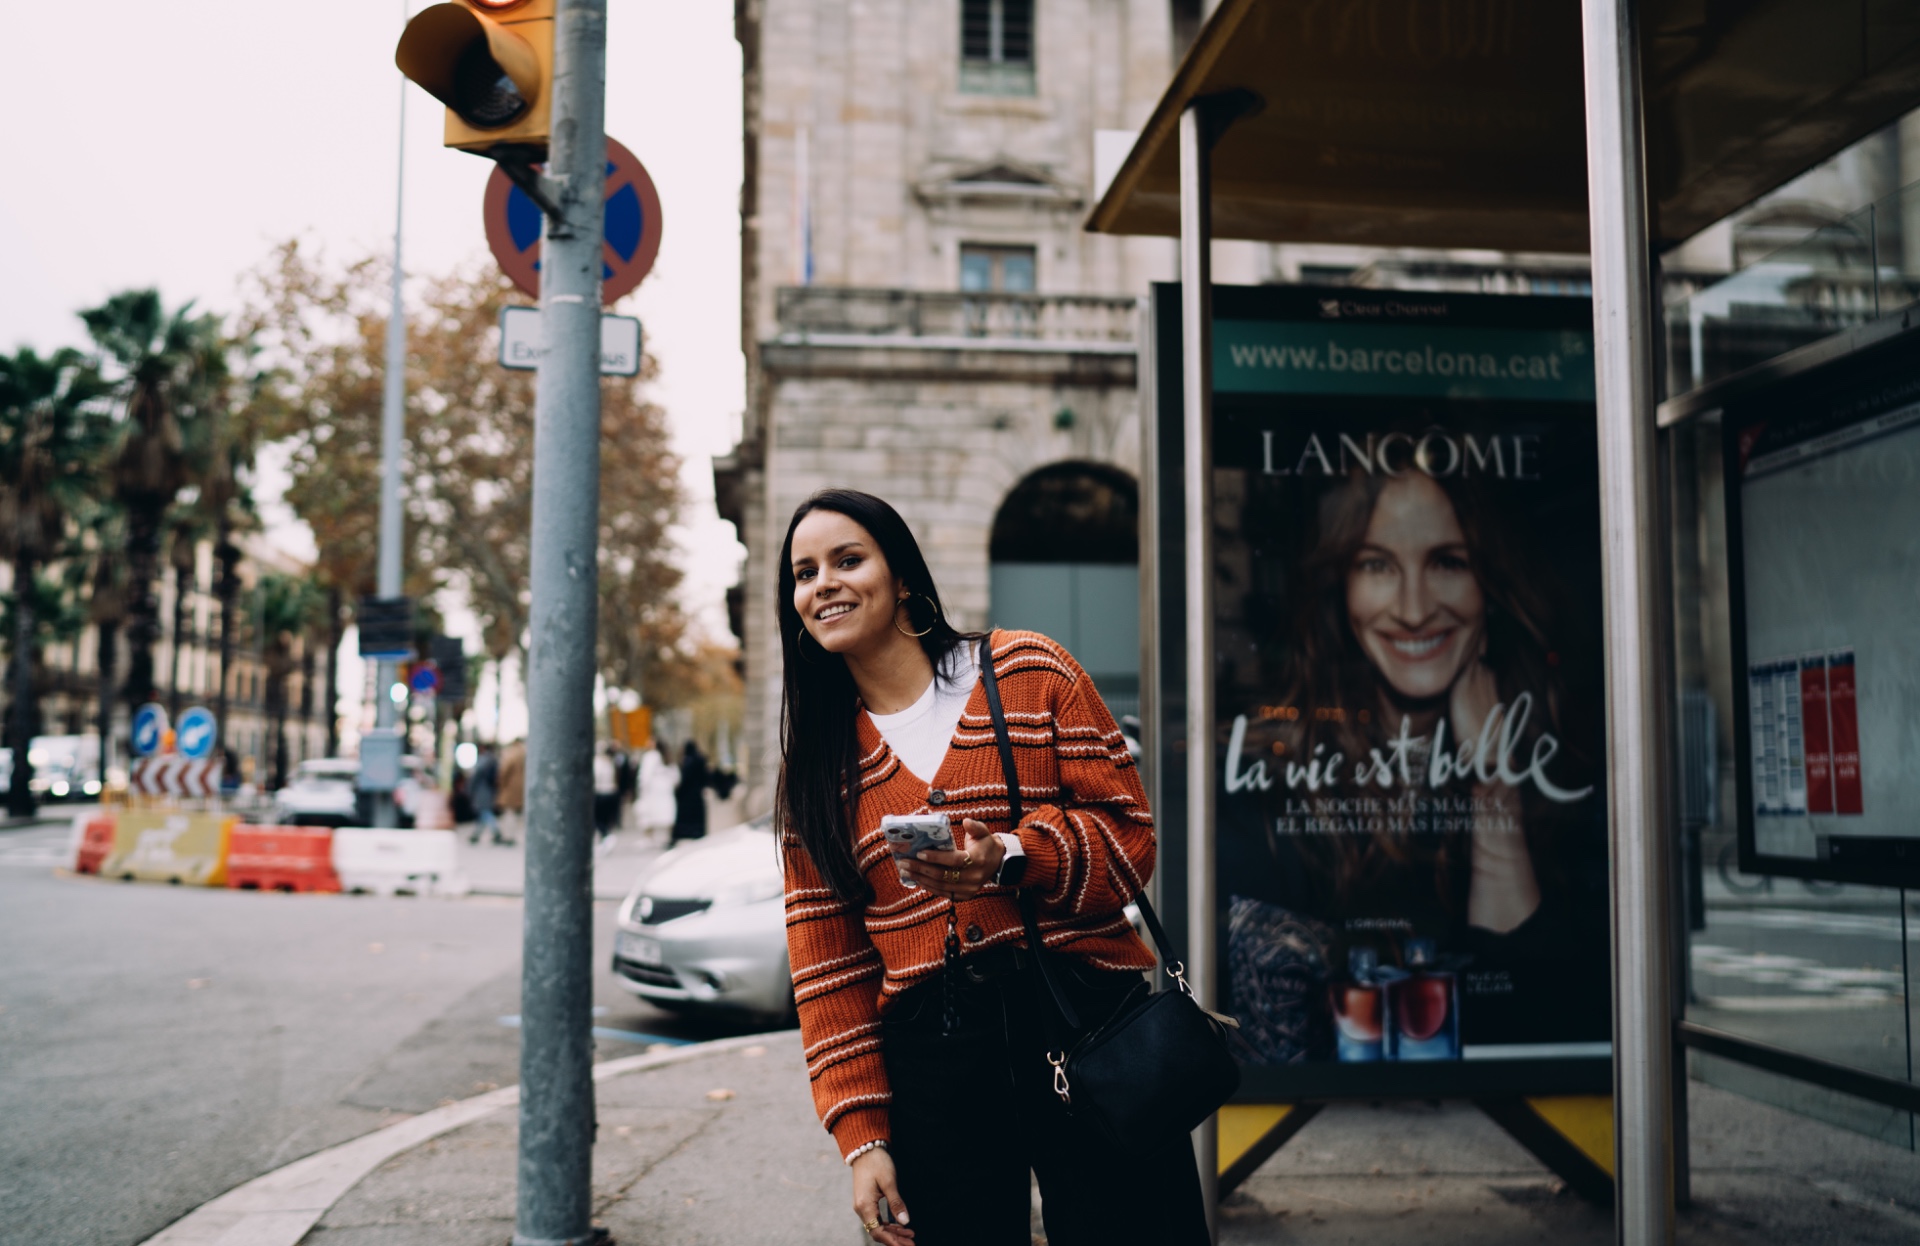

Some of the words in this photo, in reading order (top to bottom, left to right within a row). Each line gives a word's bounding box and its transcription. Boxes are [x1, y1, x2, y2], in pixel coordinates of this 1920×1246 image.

[1341, 299, 1382, 316] Clear
[1384, 300, 1448, 317] Channel
[1230, 341, 1562, 380] www.barcelona.cat
[1261, 425, 1541, 480] LANCÔME
[1285, 742, 1344, 792] vie
[1354, 714, 1425, 789] est
[1429, 691, 1594, 801] belle
[1285, 797, 1311, 815] LA
[1314, 797, 1383, 815] NOCHE
[1276, 815, 1301, 833] EL
[1304, 815, 1385, 833] REGALO
[1432, 815, 1519, 833] ESPECIAL
